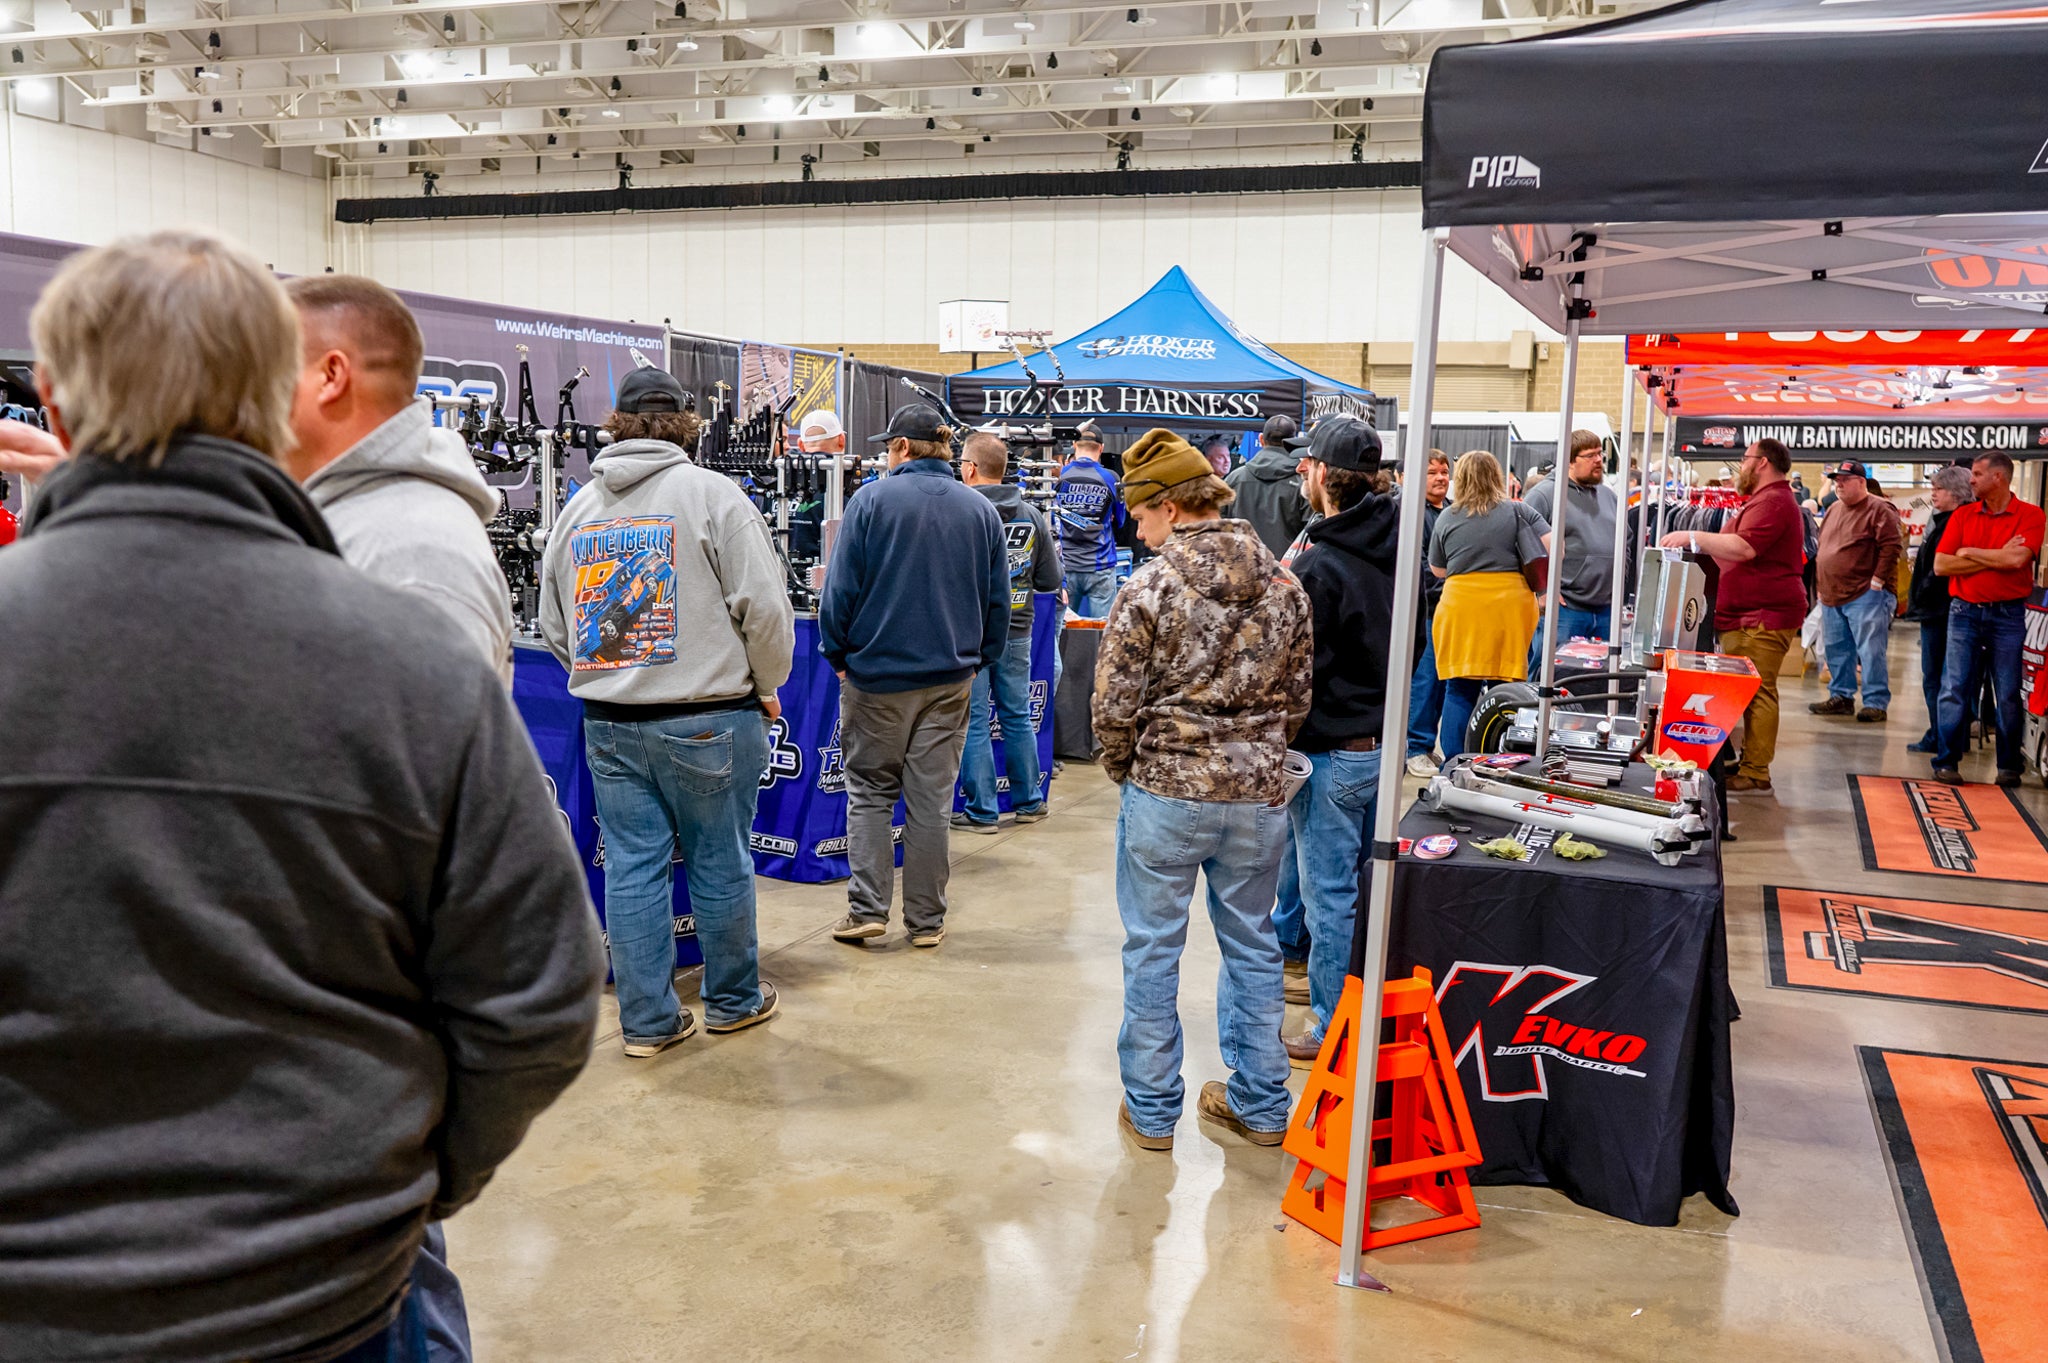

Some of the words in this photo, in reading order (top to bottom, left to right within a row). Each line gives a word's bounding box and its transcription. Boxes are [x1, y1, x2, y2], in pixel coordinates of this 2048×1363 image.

[496, 319, 662, 350] www.WehrsMachine.com
[1127, 334, 1215, 350] HOOKER
[1743, 425, 2028, 449] WWW.BATWINGCHASSIS.COM
[1069, 484, 1108, 496] ULTRA
[1470, 697, 1496, 731] RACER
[1669, 724, 1721, 736] KEVKO
[1510, 1046, 1553, 1054] DRIVE
[1556, 1052, 1608, 1070] SHAFTS
